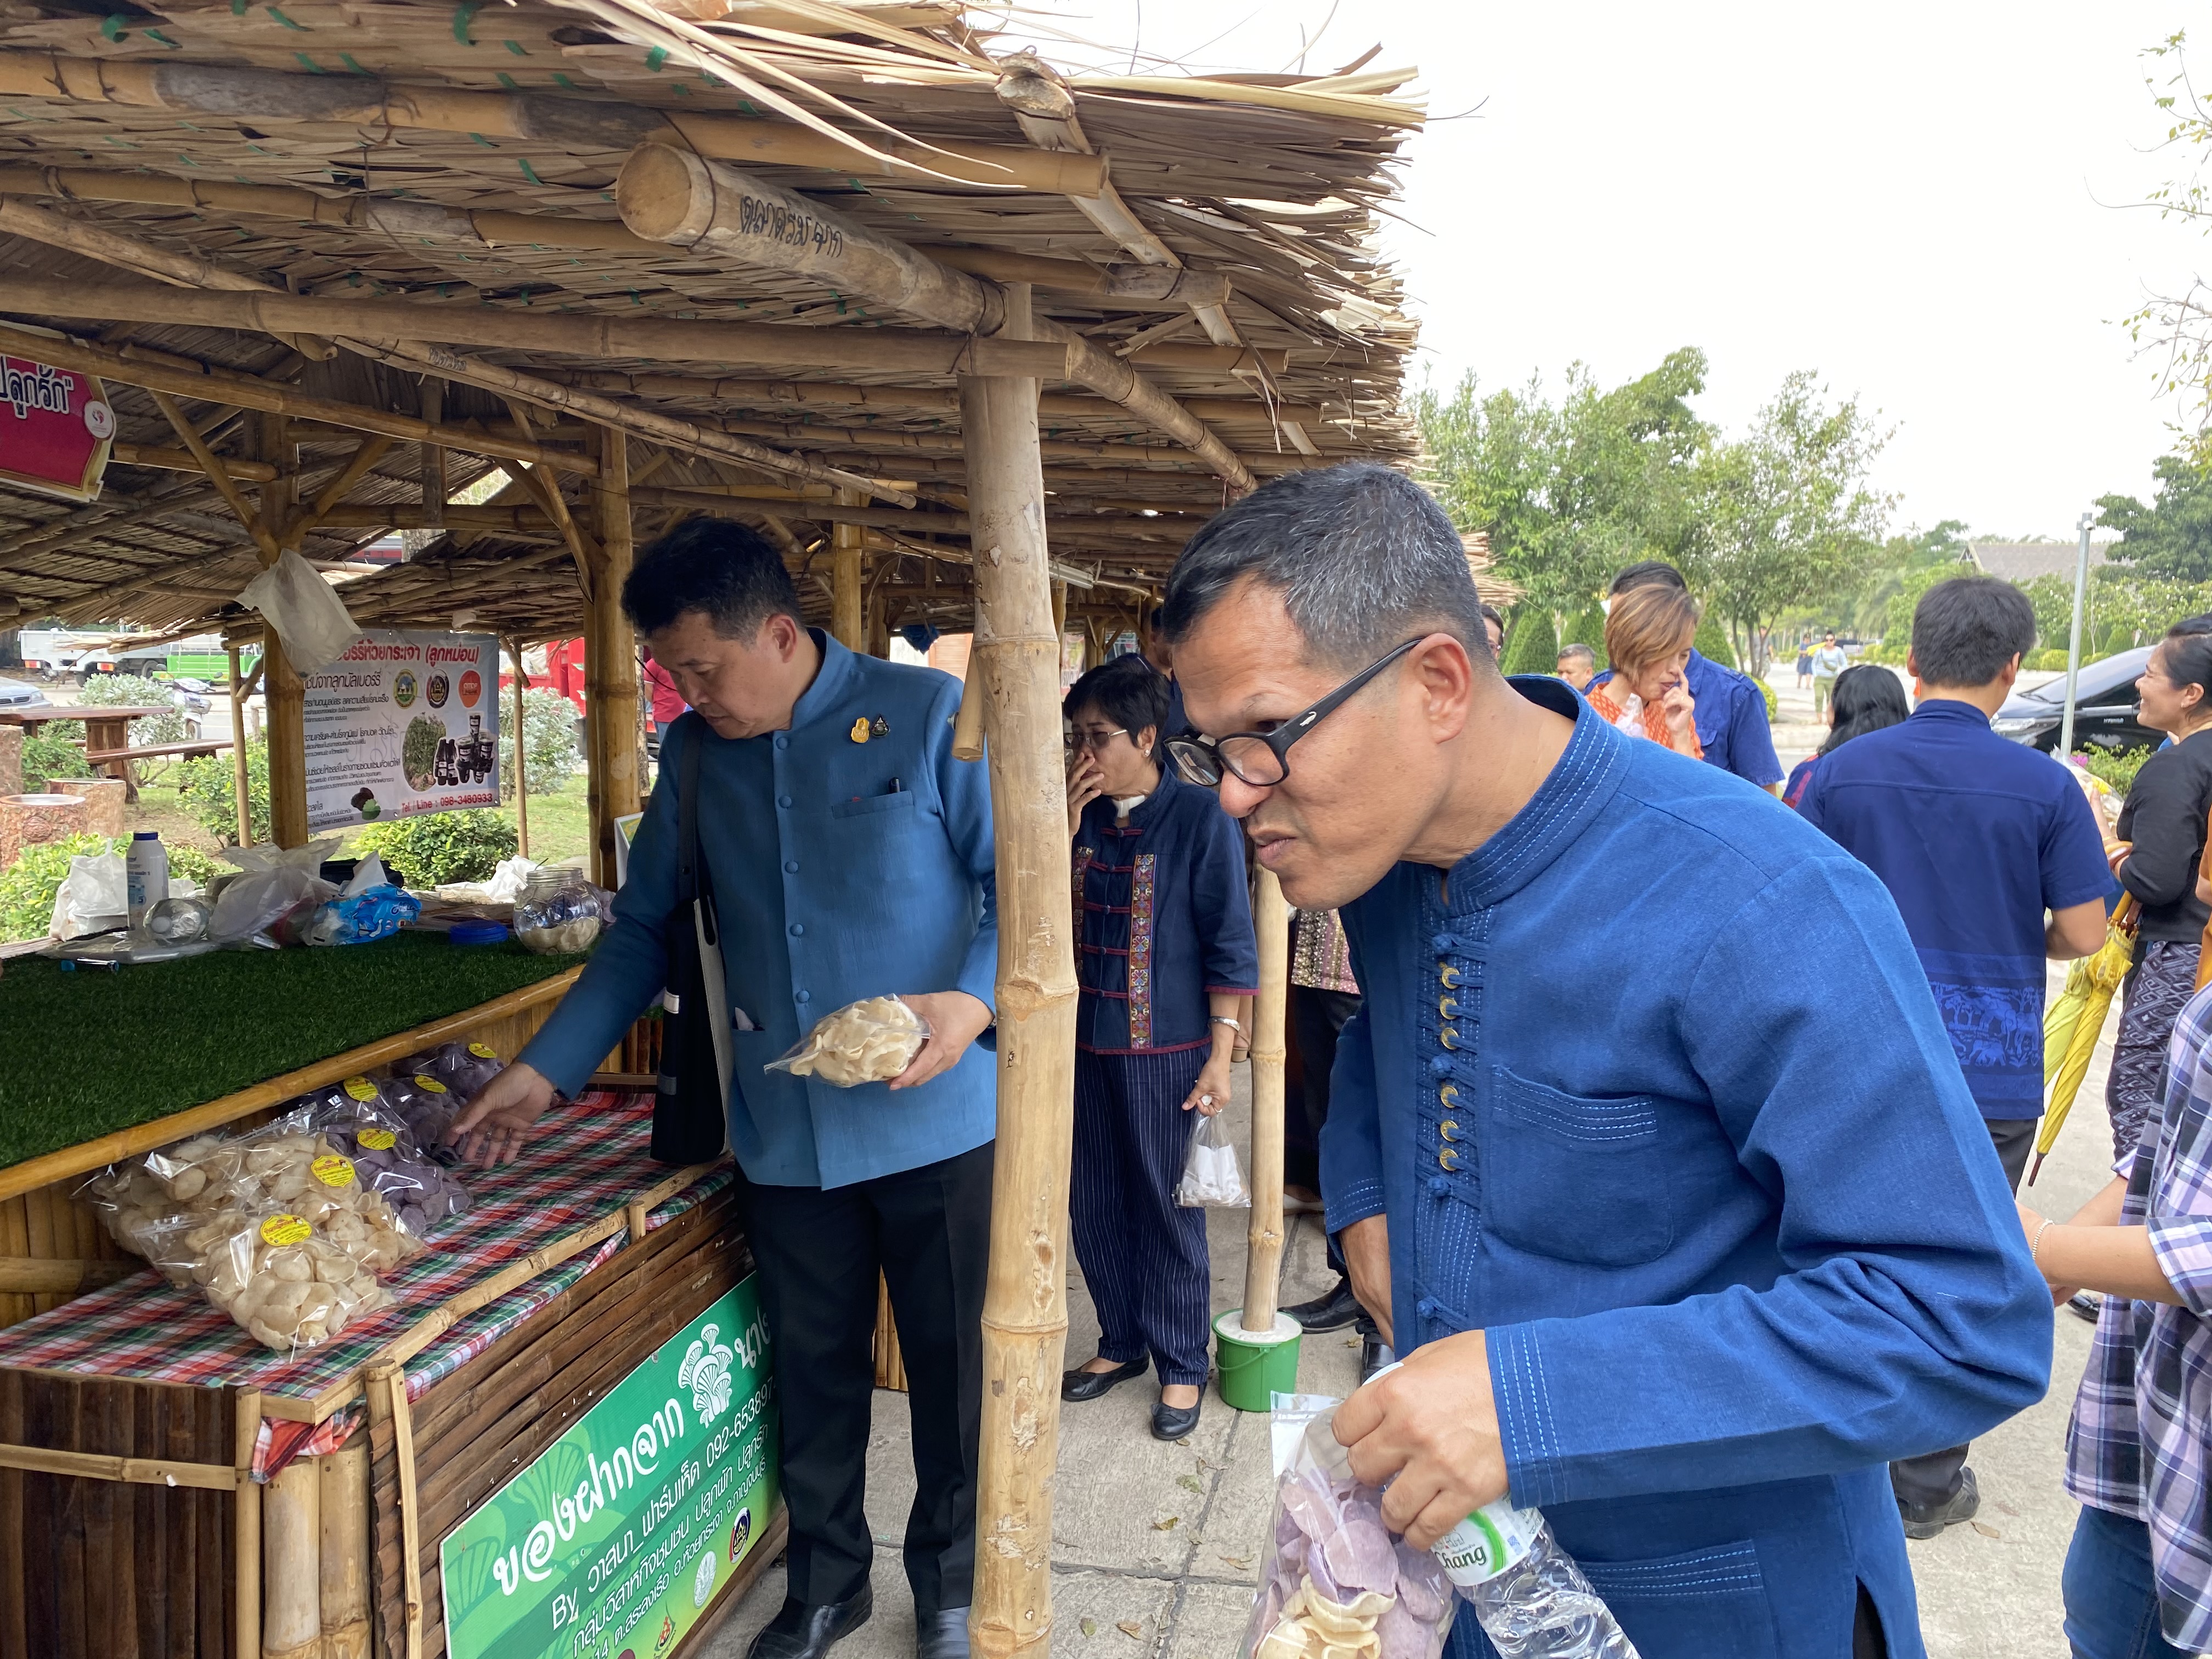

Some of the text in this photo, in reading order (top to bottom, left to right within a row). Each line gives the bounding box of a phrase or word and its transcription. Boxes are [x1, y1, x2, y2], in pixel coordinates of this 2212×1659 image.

[417, 799, 432, 810] Line
[440, 793, 493, 806] 098-3480933
[493, 1397, 685, 1597] ของฝากจาก
[552, 1587, 578, 1630] By
[706, 1375, 775, 1468] 092-653897
[1434, 1545, 1487, 1570] Chang
[574, 1515, 690, 1658] กลุ่มวิสาหกิจชุมชน
